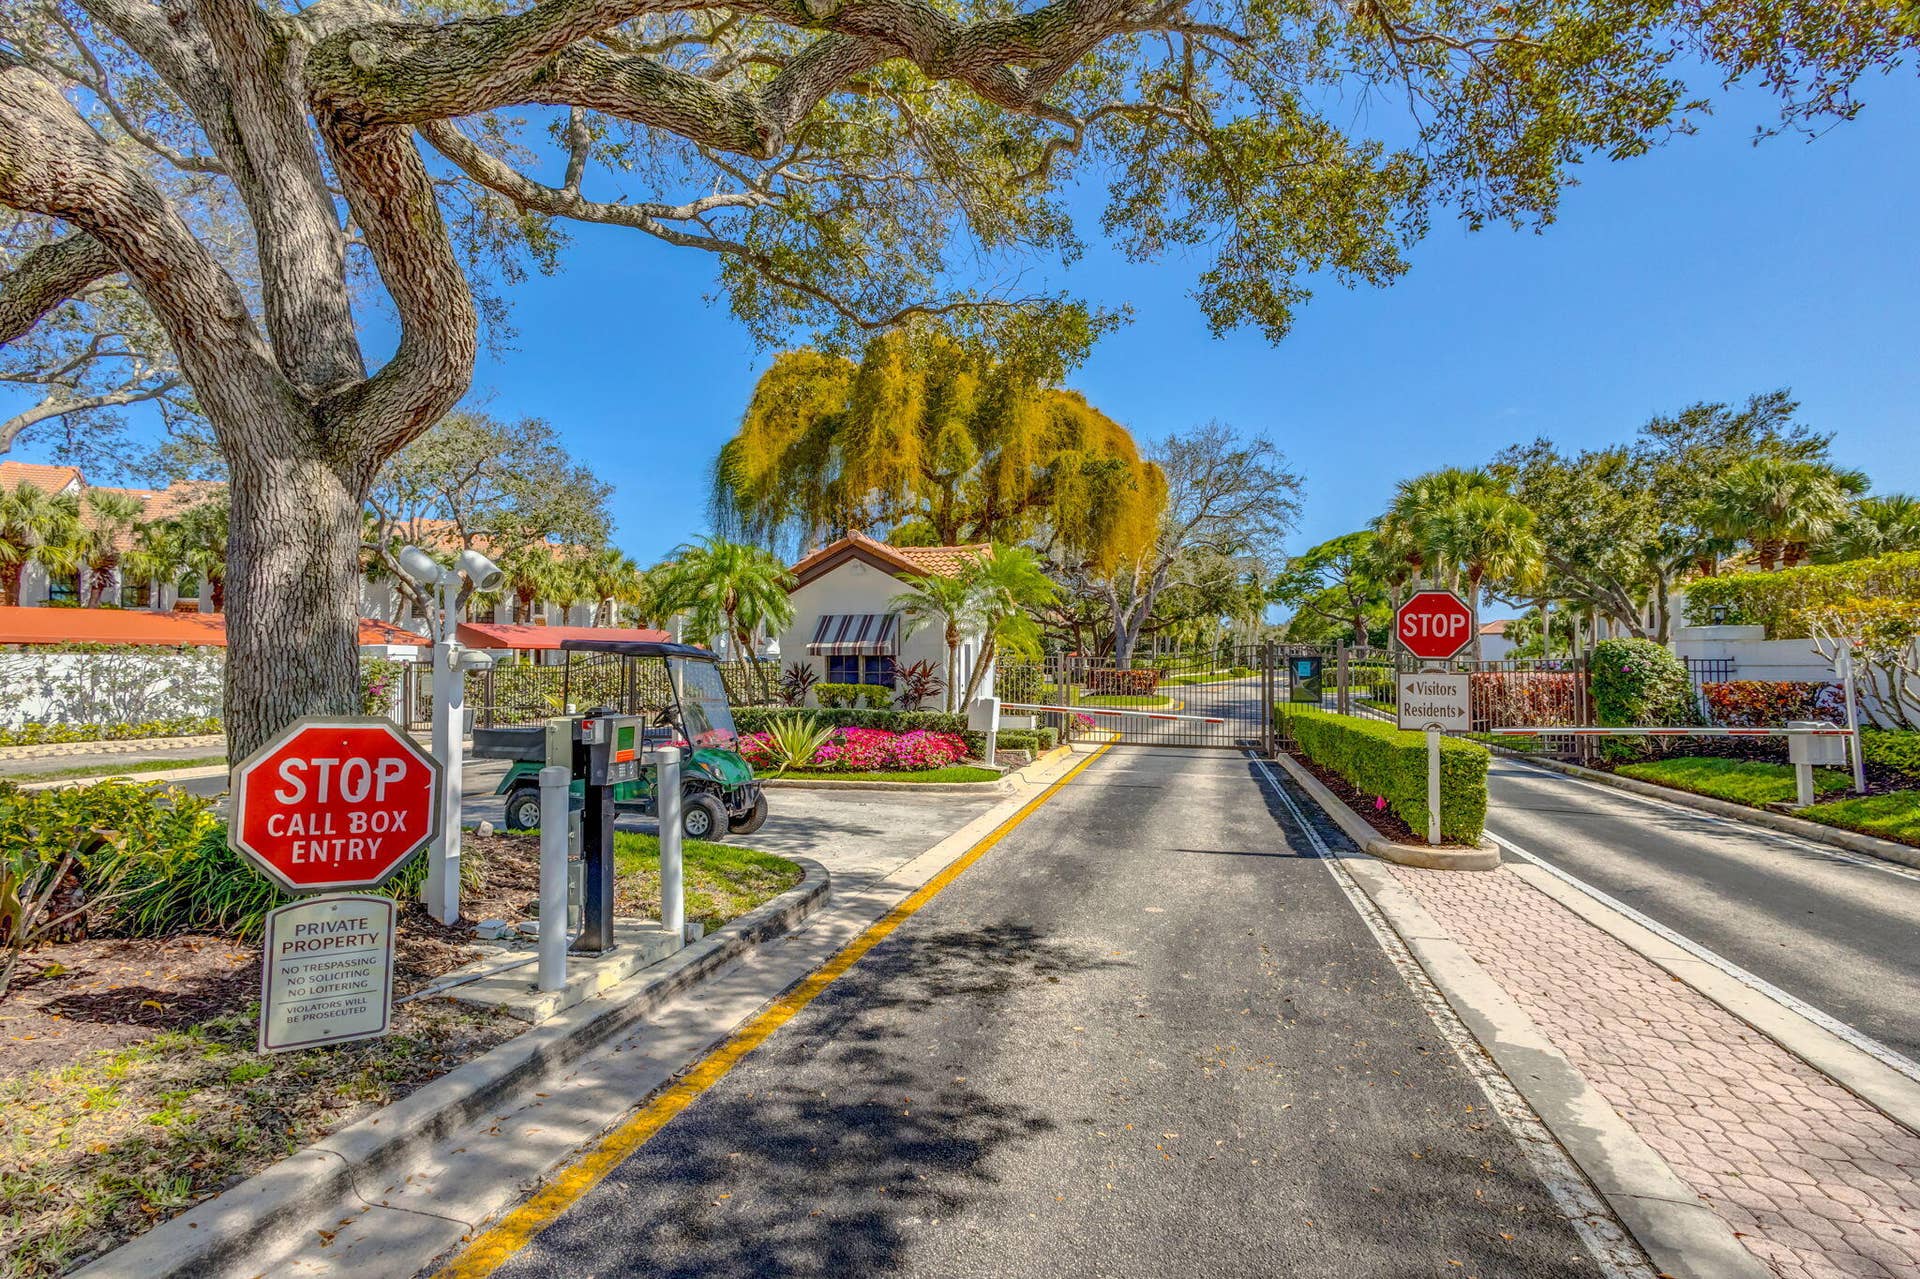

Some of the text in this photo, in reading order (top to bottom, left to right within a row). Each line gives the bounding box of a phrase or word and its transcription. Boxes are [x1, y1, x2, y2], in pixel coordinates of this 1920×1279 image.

[1402, 614, 1466, 637] STOP
[1416, 681, 1456, 696] Visitors
[1404, 703, 1456, 717] Residents
[274, 757, 407, 804] STOP
[267, 810, 408, 836] CALL BOX
[292, 838, 382, 864] ENTRY
[296, 918, 368, 936] PRIVATE
[282, 932, 379, 954] PROPERTY
[282, 956, 376, 975] NO TRESPASSING
[288, 968, 370, 986] NO SOLICITING
[288, 980, 368, 998] NO LOITERING
[287, 997, 368, 1014] VIOLATORS WILL
[286, 1006, 366, 1024] BE PROSECUTED
